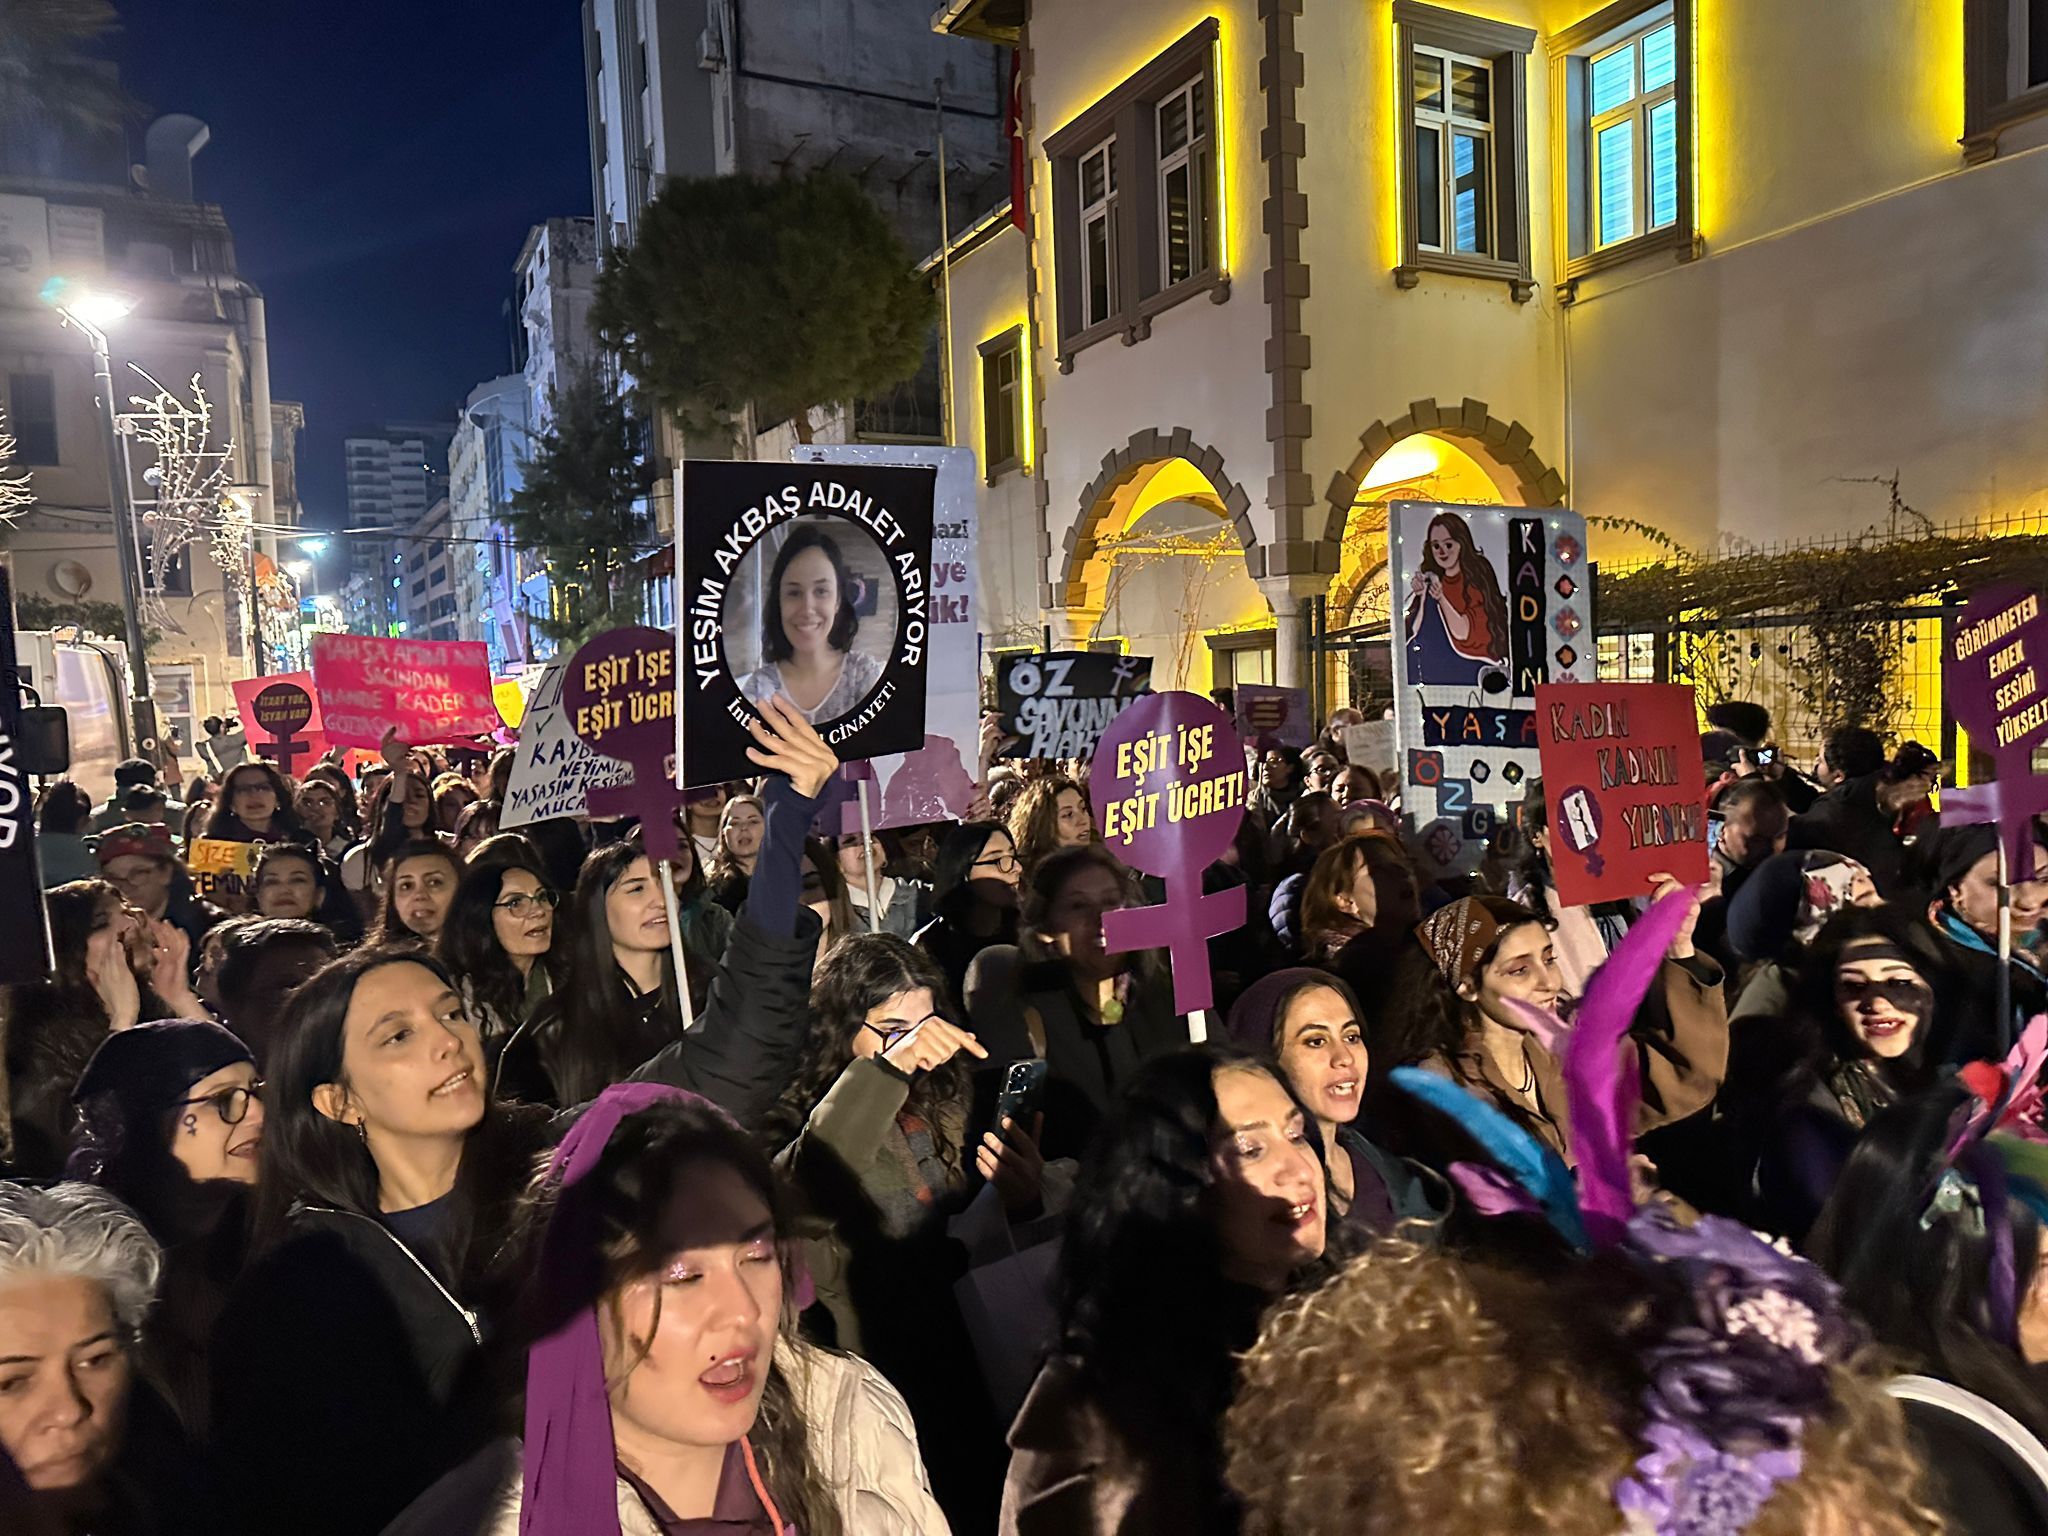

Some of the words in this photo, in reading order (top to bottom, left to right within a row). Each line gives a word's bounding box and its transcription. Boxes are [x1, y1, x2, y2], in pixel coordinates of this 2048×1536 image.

[690, 577, 726, 692] YEŞİM
[713, 485, 801, 575] AKBAŞ
[807, 480, 906, 549] ADALET
[895, 551, 926, 667] ARIYOR
[1515, 521, 1543, 694] KADIN
[1955, 594, 2038, 661] GÖRÜNMEYEN
[584, 654, 631, 695] EŞİT
[635, 649, 671, 686] İŞE
[1009, 655, 1076, 697] ÖZ
[1989, 639, 2025, 679] EMEK
[395, 690, 466, 713] KADER
[1996, 666, 2036, 711] SESİNİ
[577, 698, 623, 740] EŞİT
[829, 680, 896, 745] CİNAYET!
[1551, 699, 1629, 743] KADIN
[1116, 727, 1171, 786] EŞİT
[1178, 724, 1213, 775] İŞE
[1104, 790, 1159, 845] EŞİT
[1166, 771, 1244, 823] ÜCRET!
